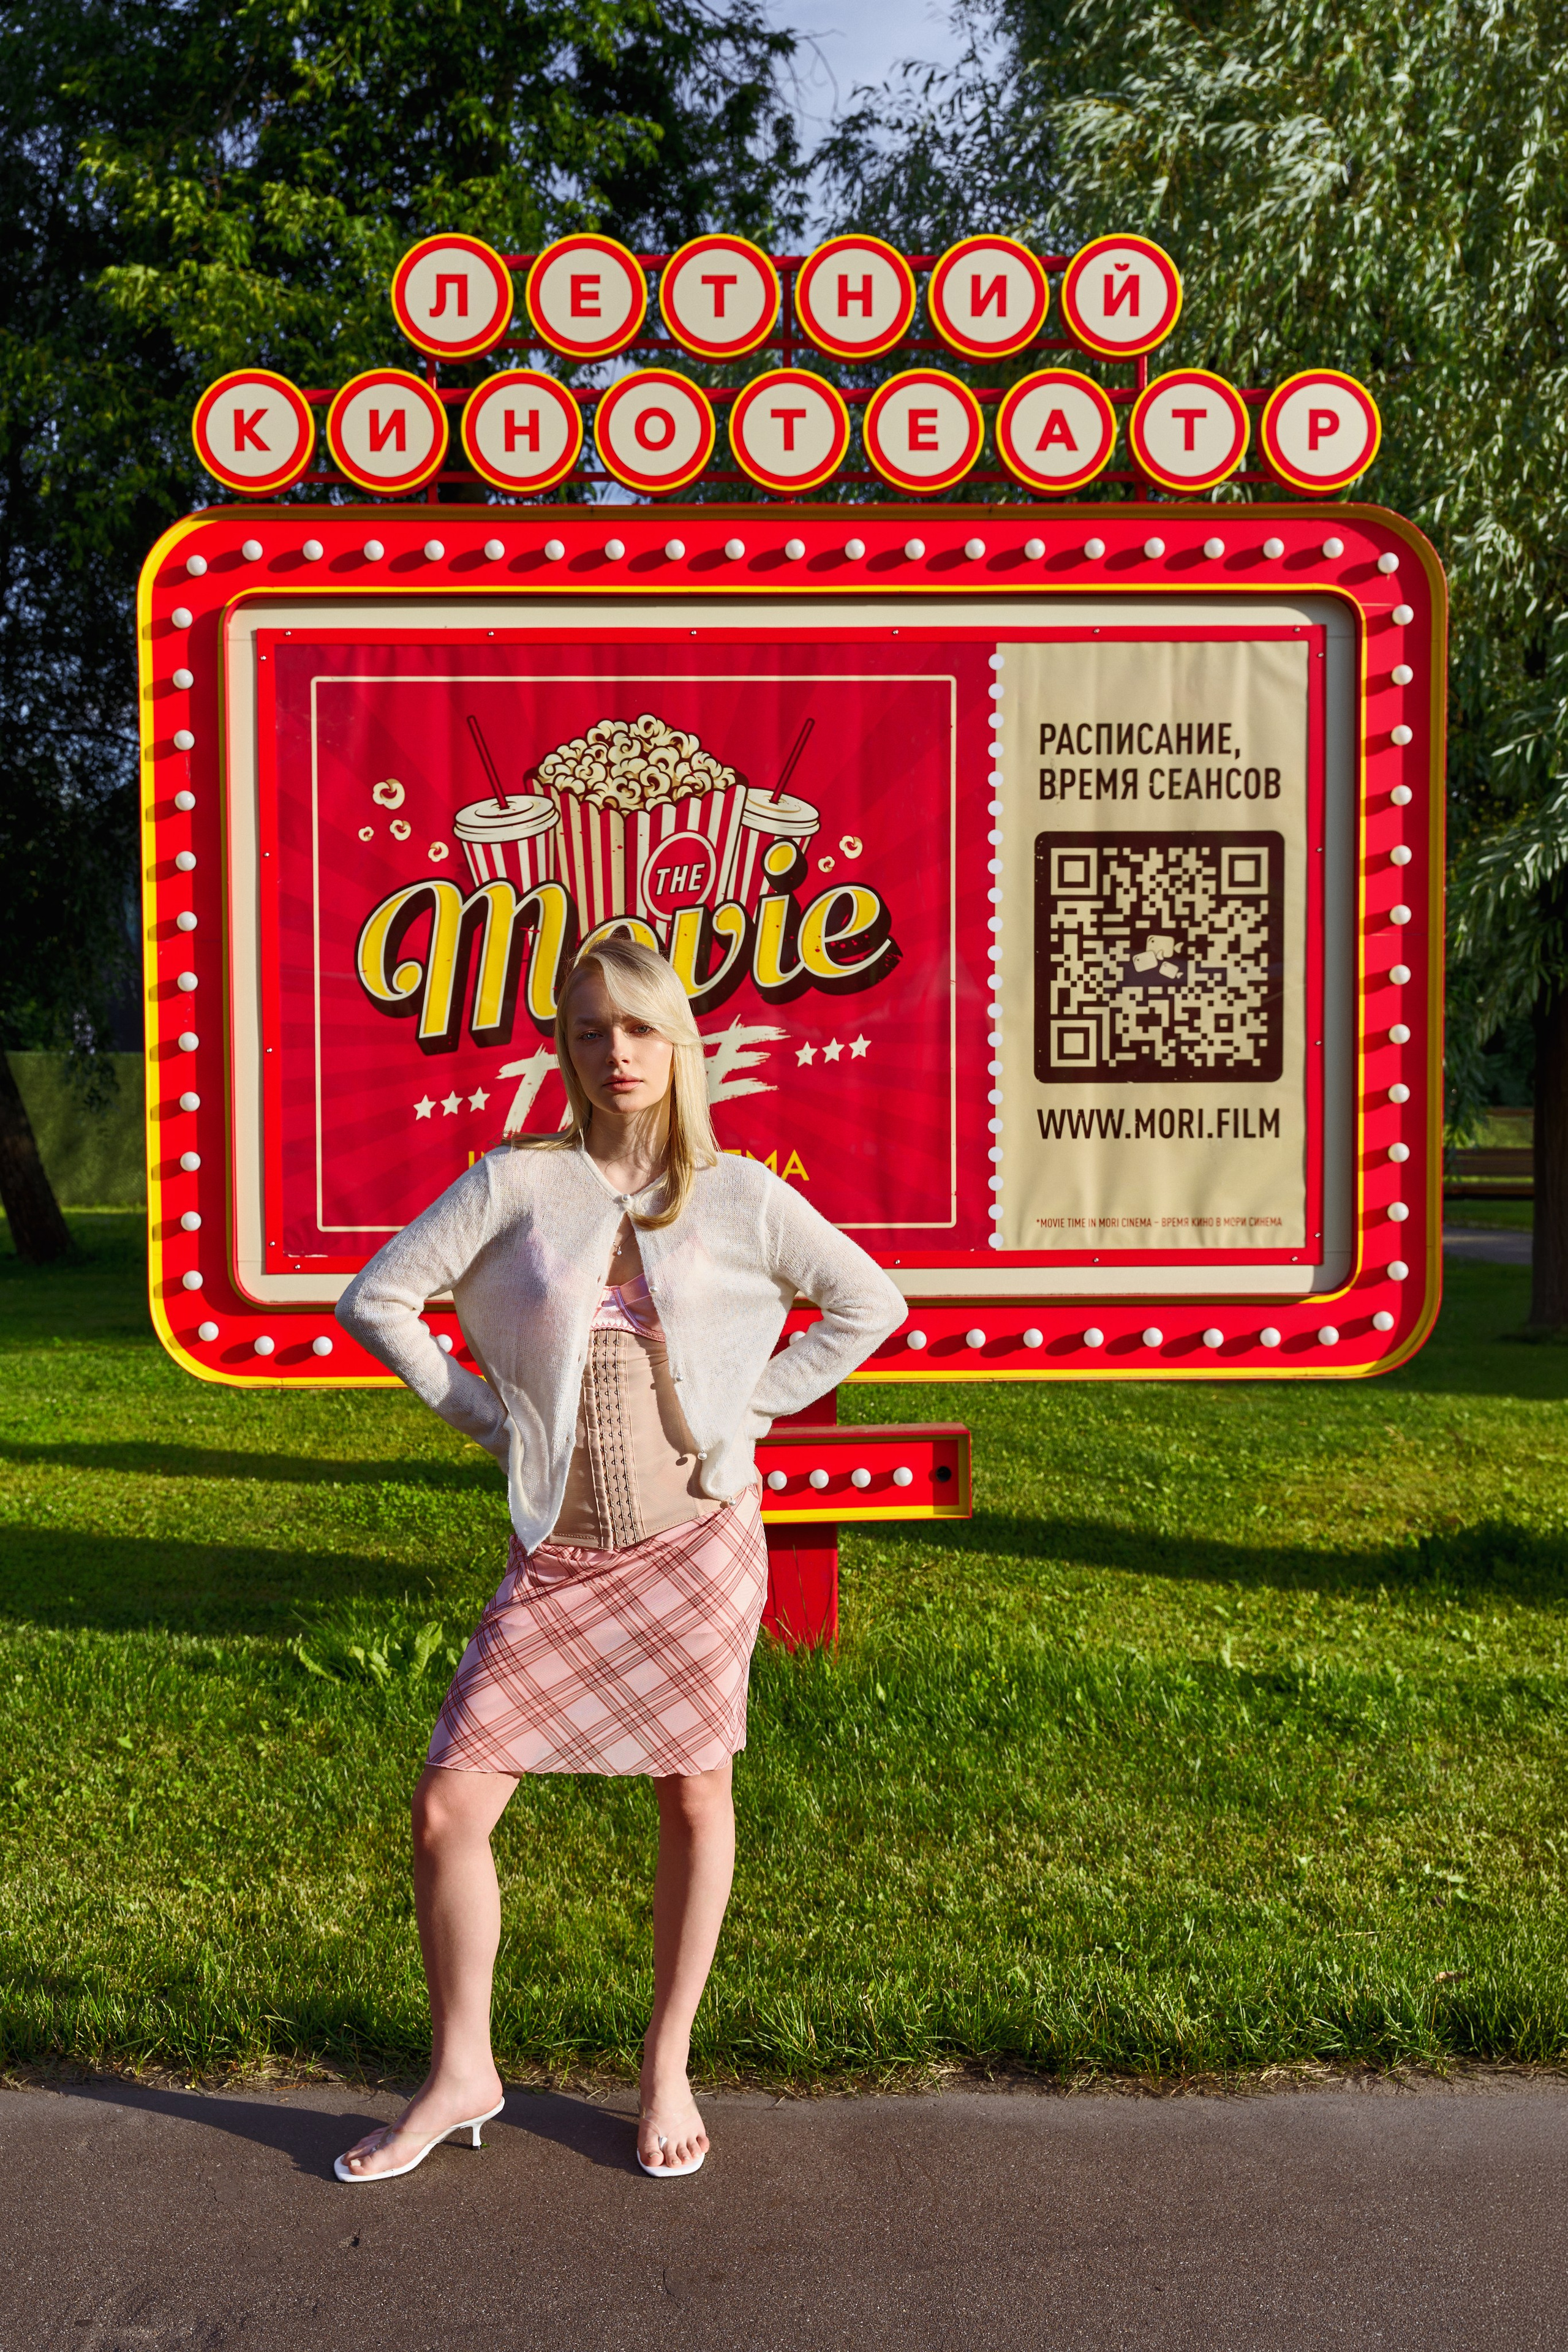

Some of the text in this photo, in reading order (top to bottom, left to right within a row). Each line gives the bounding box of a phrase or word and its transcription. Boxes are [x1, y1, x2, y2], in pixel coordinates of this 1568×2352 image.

[428, 263, 1142, 318] ЛЕТНИЙ
[232, 407, 1342, 453] КИНОТЕАТР
[1039, 723, 1241, 760] РАСПИСАНИЕ,
[1039, 767, 1282, 801] ВРЕМЯ СЕАНСОВ
[656, 862, 706, 896] THE
[495, 1014, 794, 1139] TE
[1036, 1107, 1281, 1140] WWW.MORI.FILM
[1067, 1218, 1086, 1228] TIME
[1088, 1218, 1096, 1227] IN
[1099, 1217, 1120, 1227] MORI
[1121, 1217, 1152, 1227] CINEMA
[1161, 1217, 1189, 1227] ВРЕМЯ
[1191, 1217, 1214, 1227] КИНО
[1216, 1216, 1221, 1227] В
[1249, 1216, 1283, 1227] СИНЕМА
